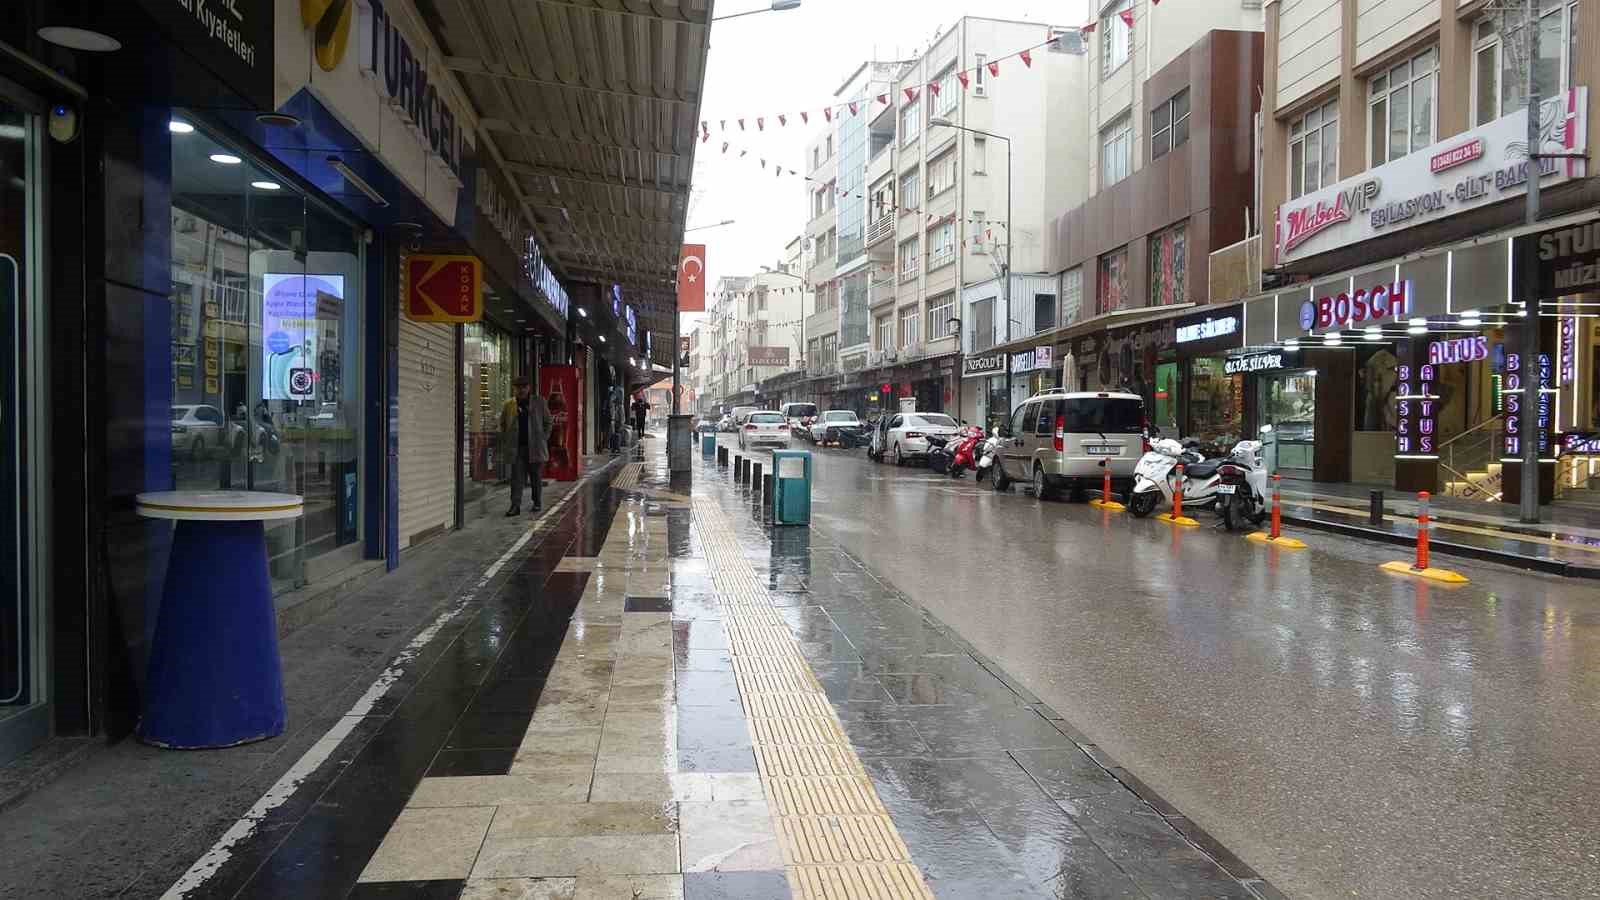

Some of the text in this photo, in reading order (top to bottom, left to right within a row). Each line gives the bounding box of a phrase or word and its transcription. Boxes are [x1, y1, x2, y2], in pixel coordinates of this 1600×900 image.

[1286, 192, 1349, 248] Mabel
[460, 264, 471, 313] KODAK
[1318, 280, 1410, 329] BOSCH
[1429, 337, 1488, 365] ALTUS
[1399, 365, 1409, 452] BOSCH
[1420, 364, 1434, 452] ALTUS
